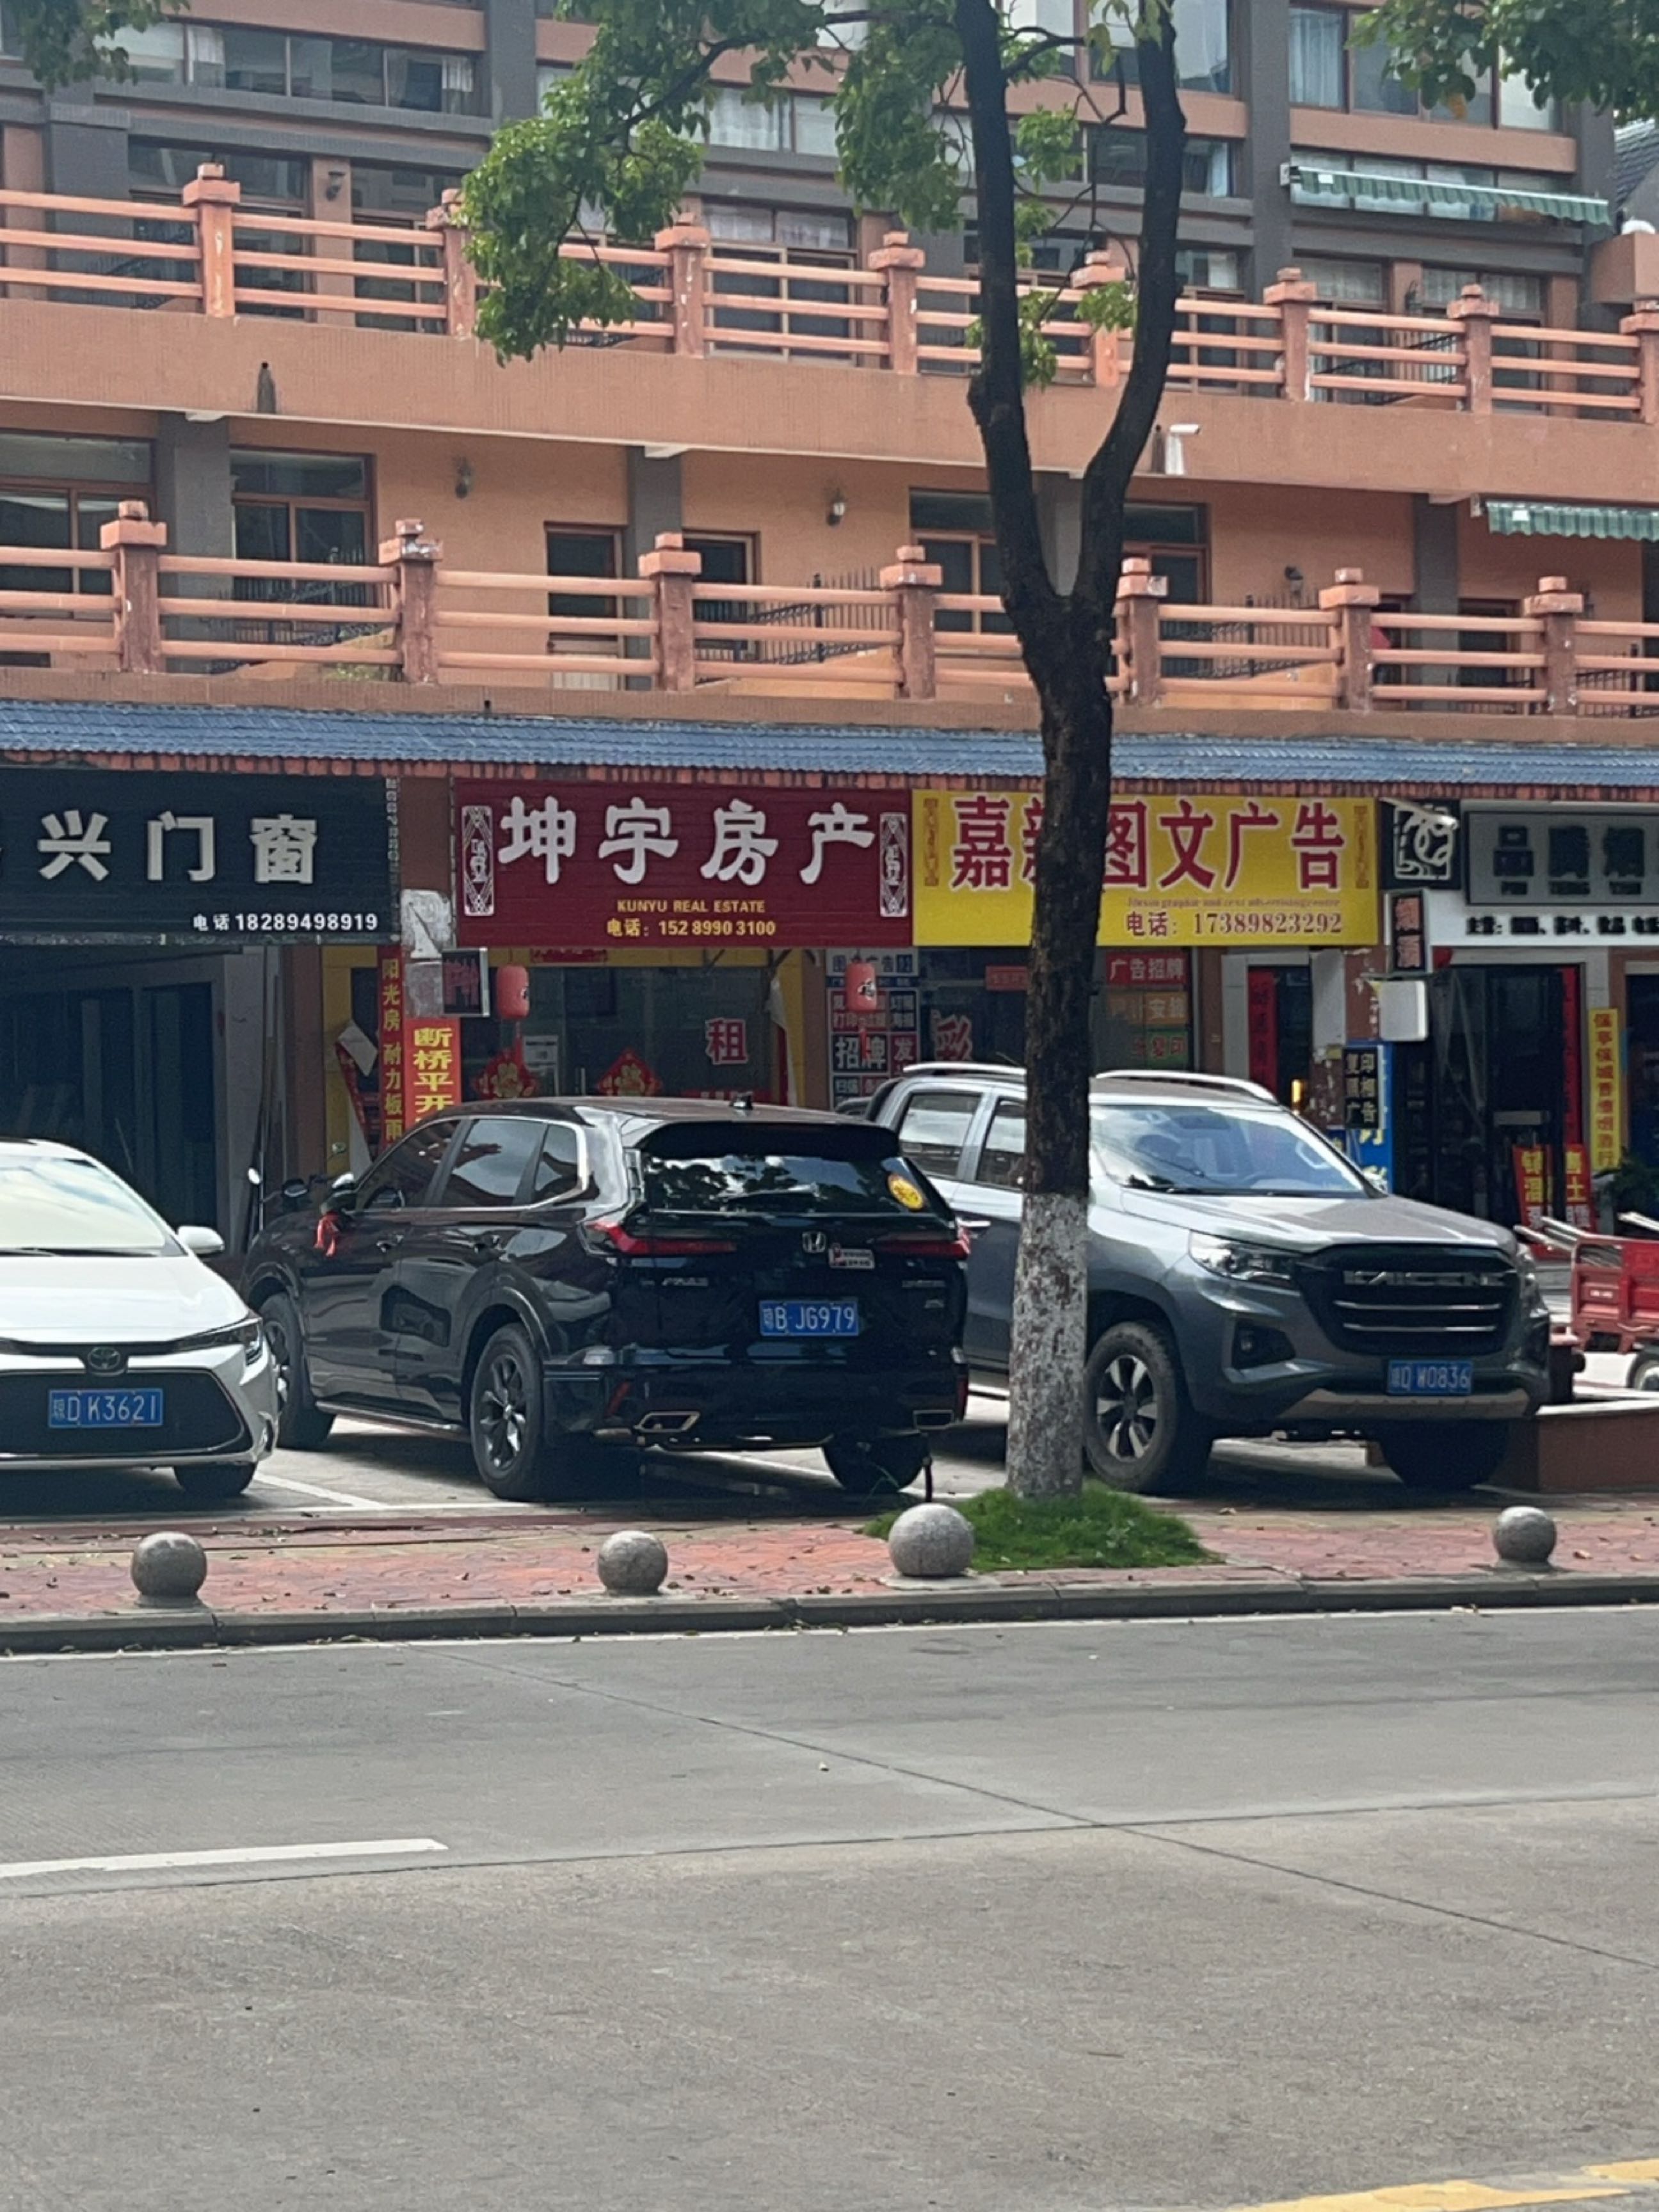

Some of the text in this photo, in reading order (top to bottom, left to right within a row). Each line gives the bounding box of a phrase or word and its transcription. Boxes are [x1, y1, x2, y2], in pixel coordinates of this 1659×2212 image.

[38, 810, 317, 884] 兴门窗
[497, 796, 876, 886] 坤宇房产
[235, 913, 378, 932] 18289498919
[617, 900, 766, 913] KUNYU REAL ESTATE
[1194, 913, 1342, 934] 17389823292
[659, 920, 688, 936] 152
[707, 1018, 747, 1064] 租
[835, 1036, 886, 1070] 招牌
[413, 1027, 454, 1124] 断桥平开
